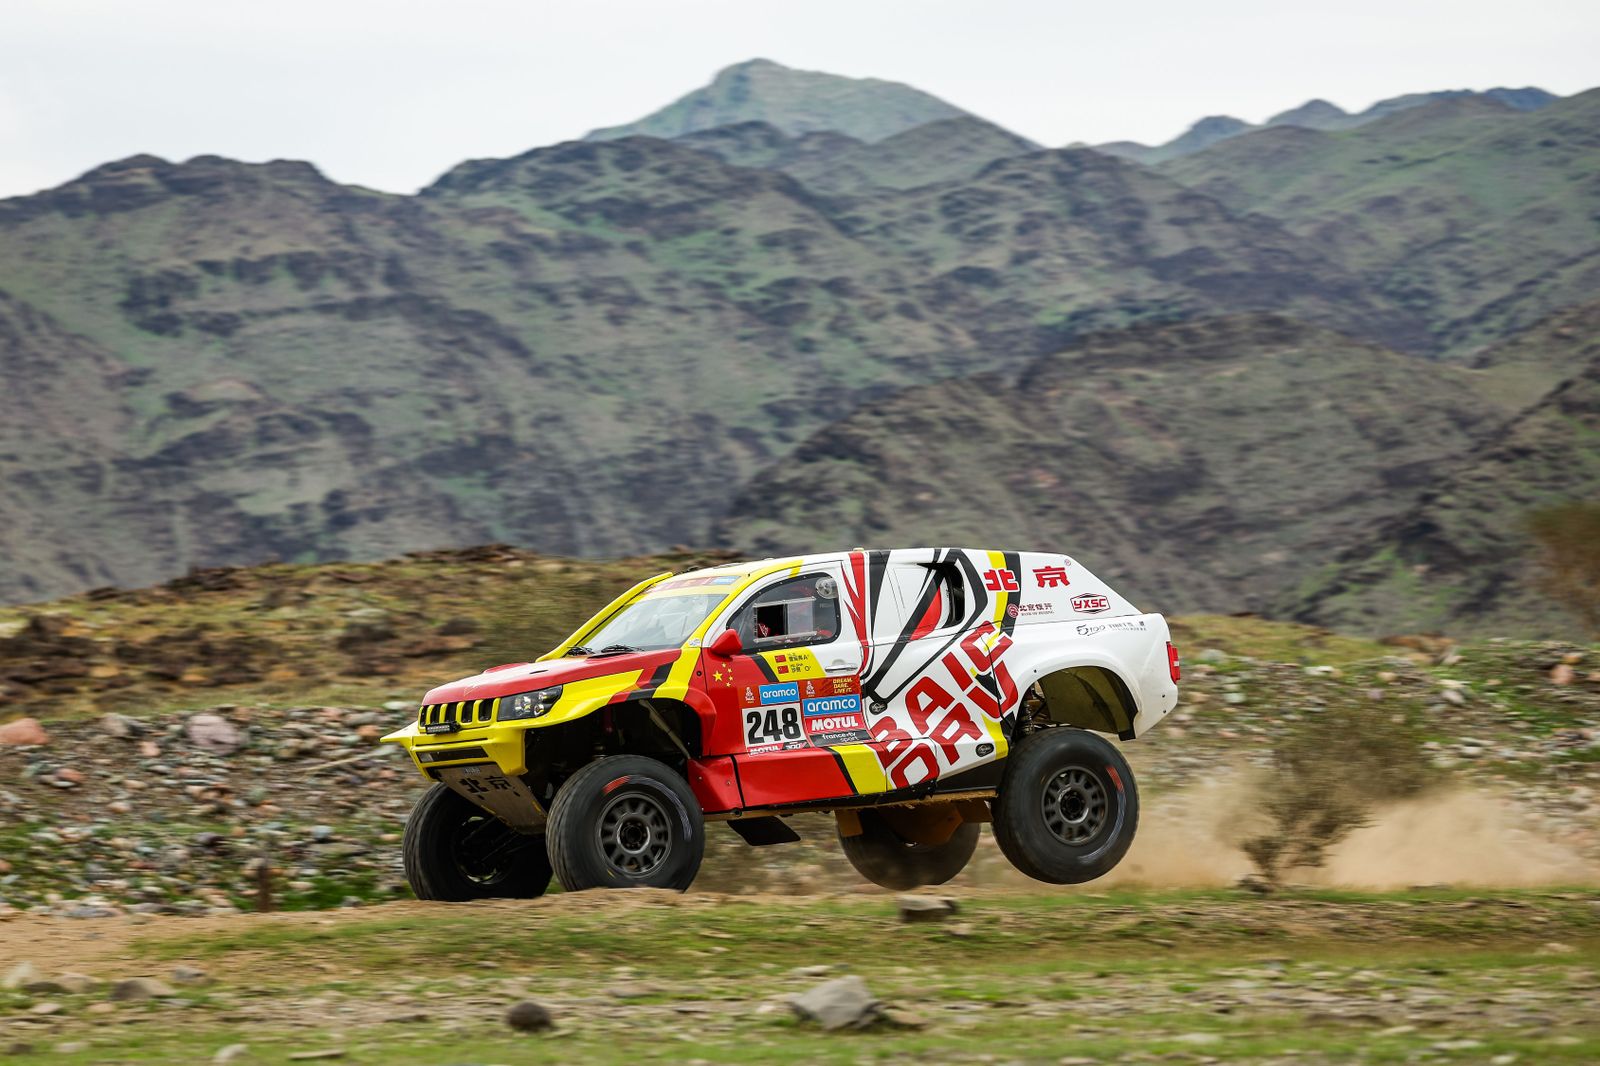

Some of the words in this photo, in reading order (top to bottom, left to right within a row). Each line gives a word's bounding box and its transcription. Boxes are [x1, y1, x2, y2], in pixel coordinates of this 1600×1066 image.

[983, 565, 1070, 591] 北京
[1073, 598, 1107, 610] YXSC
[762, 688, 797, 699] aramco
[865, 620, 1014, 769] BAIC
[807, 698, 857, 712] aramco
[746, 708, 802, 745] 248
[811, 716, 859, 731] MOTUL
[891, 660, 1019, 789] ORV
[749, 745, 779, 756] MOTUL
